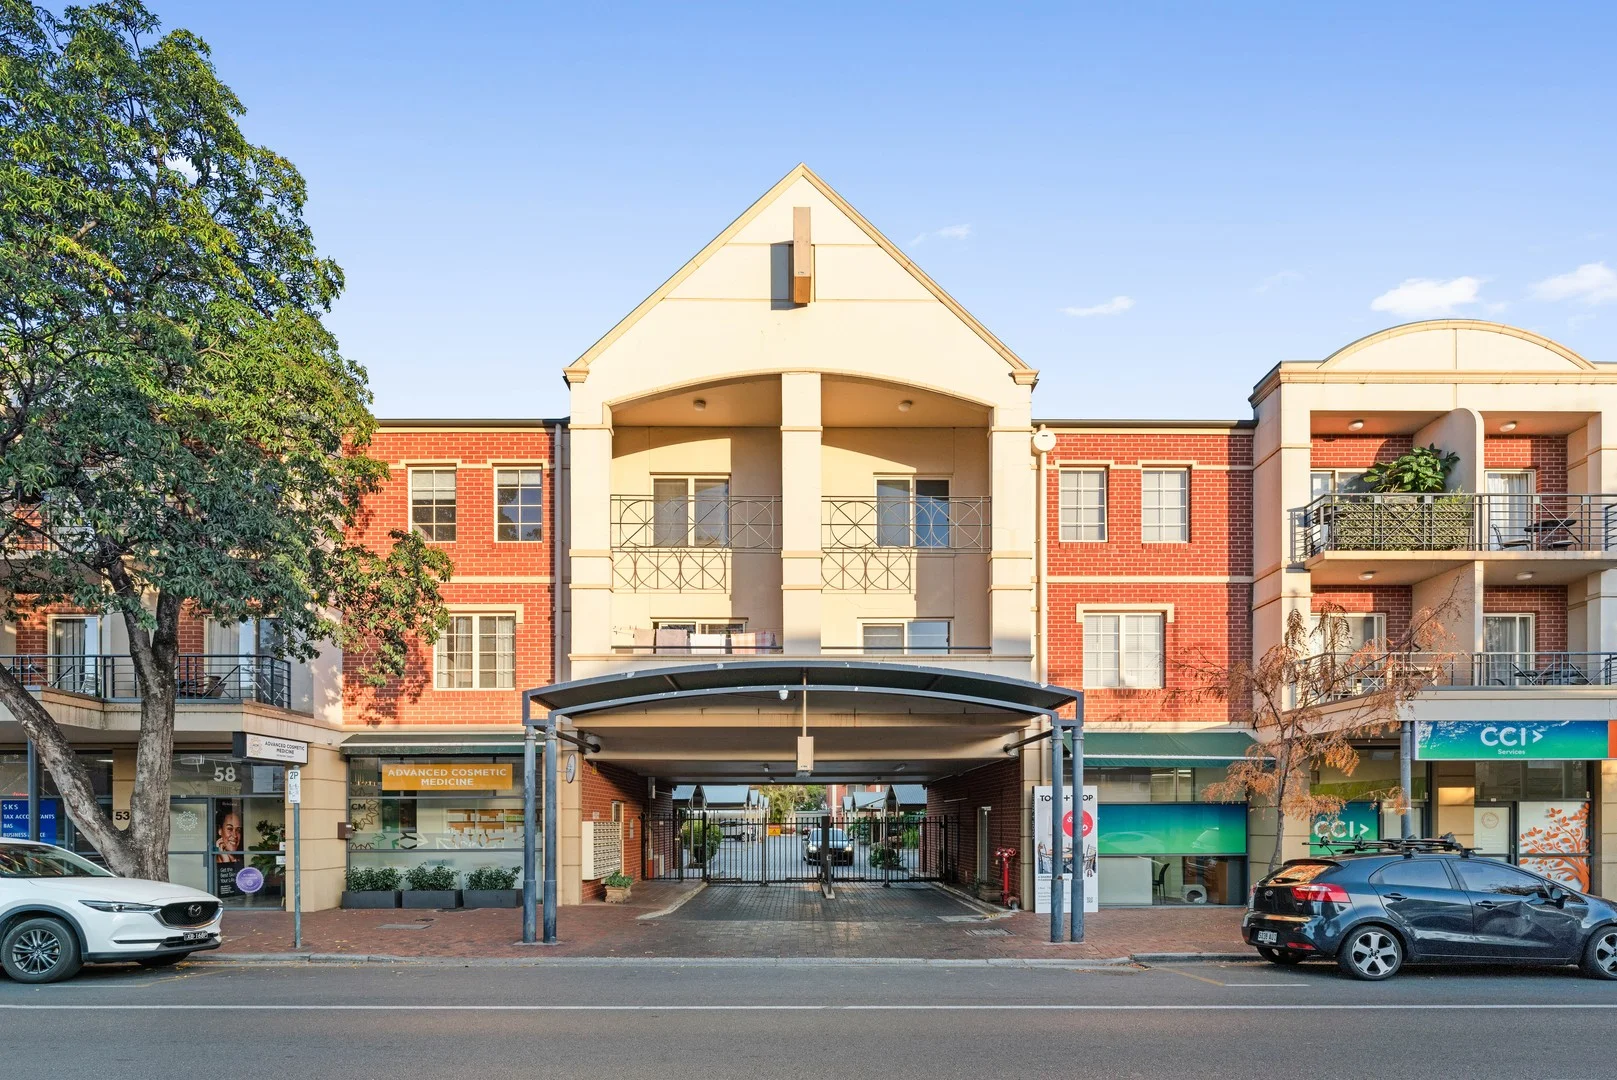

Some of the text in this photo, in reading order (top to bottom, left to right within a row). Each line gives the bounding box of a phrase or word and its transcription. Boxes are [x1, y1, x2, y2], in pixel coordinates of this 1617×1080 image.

[1481, 727, 1526, 746] CCI
[214, 767, 236, 782] 58
[290, 771, 298, 779] 2P
[388, 768, 507, 777] ADVANCED COSMETIC
[421, 778, 474, 786] MEDICINE
[351, 803, 366, 811] CM
[115, 811, 130, 821] 53
[1314, 821, 1354, 838] CCI
